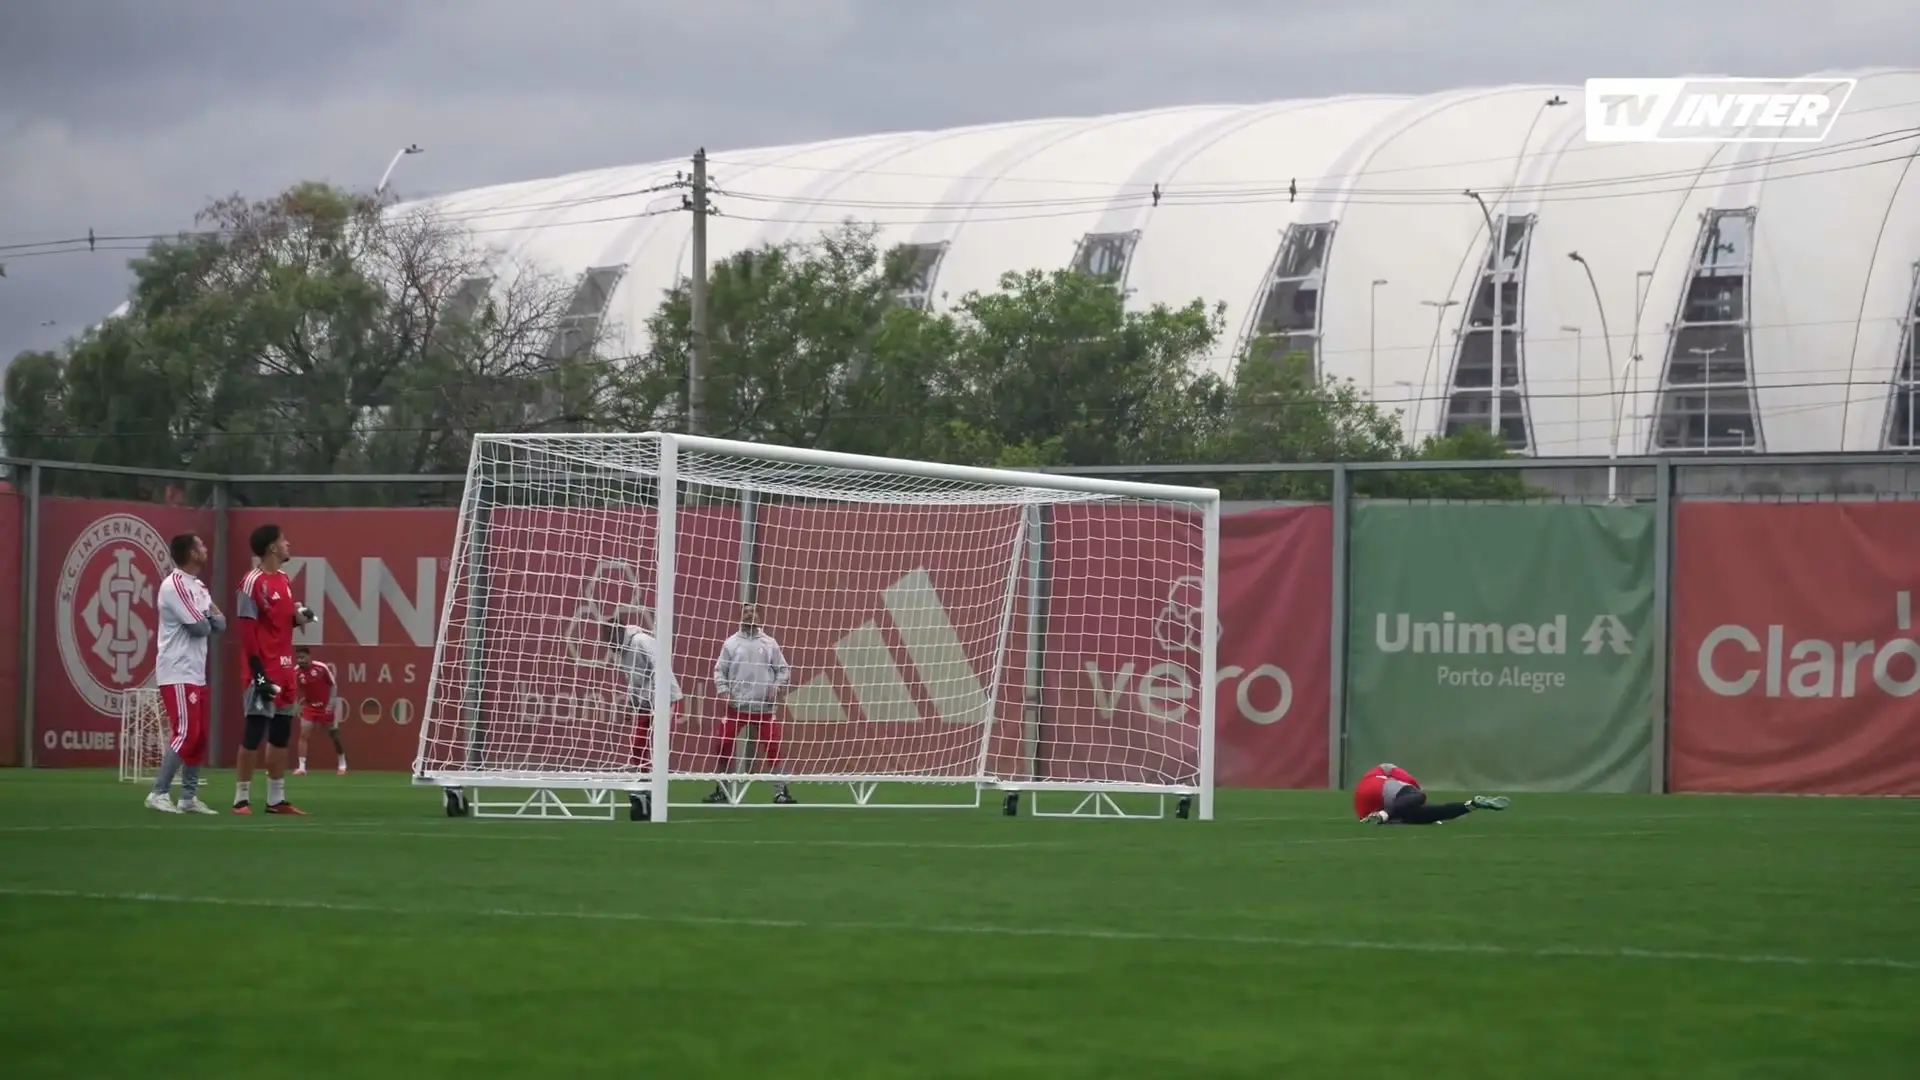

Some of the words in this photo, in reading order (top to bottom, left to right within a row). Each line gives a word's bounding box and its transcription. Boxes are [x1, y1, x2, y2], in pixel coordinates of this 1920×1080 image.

[1376, 611, 1567, 655] Unimed
[1085, 661, 1293, 724] vero
[1437, 665, 1494, 687] Porto
[1498, 666, 1566, 694] Alegre
[44, 730, 58, 750] O
[61, 730, 115, 750] CLUBE
